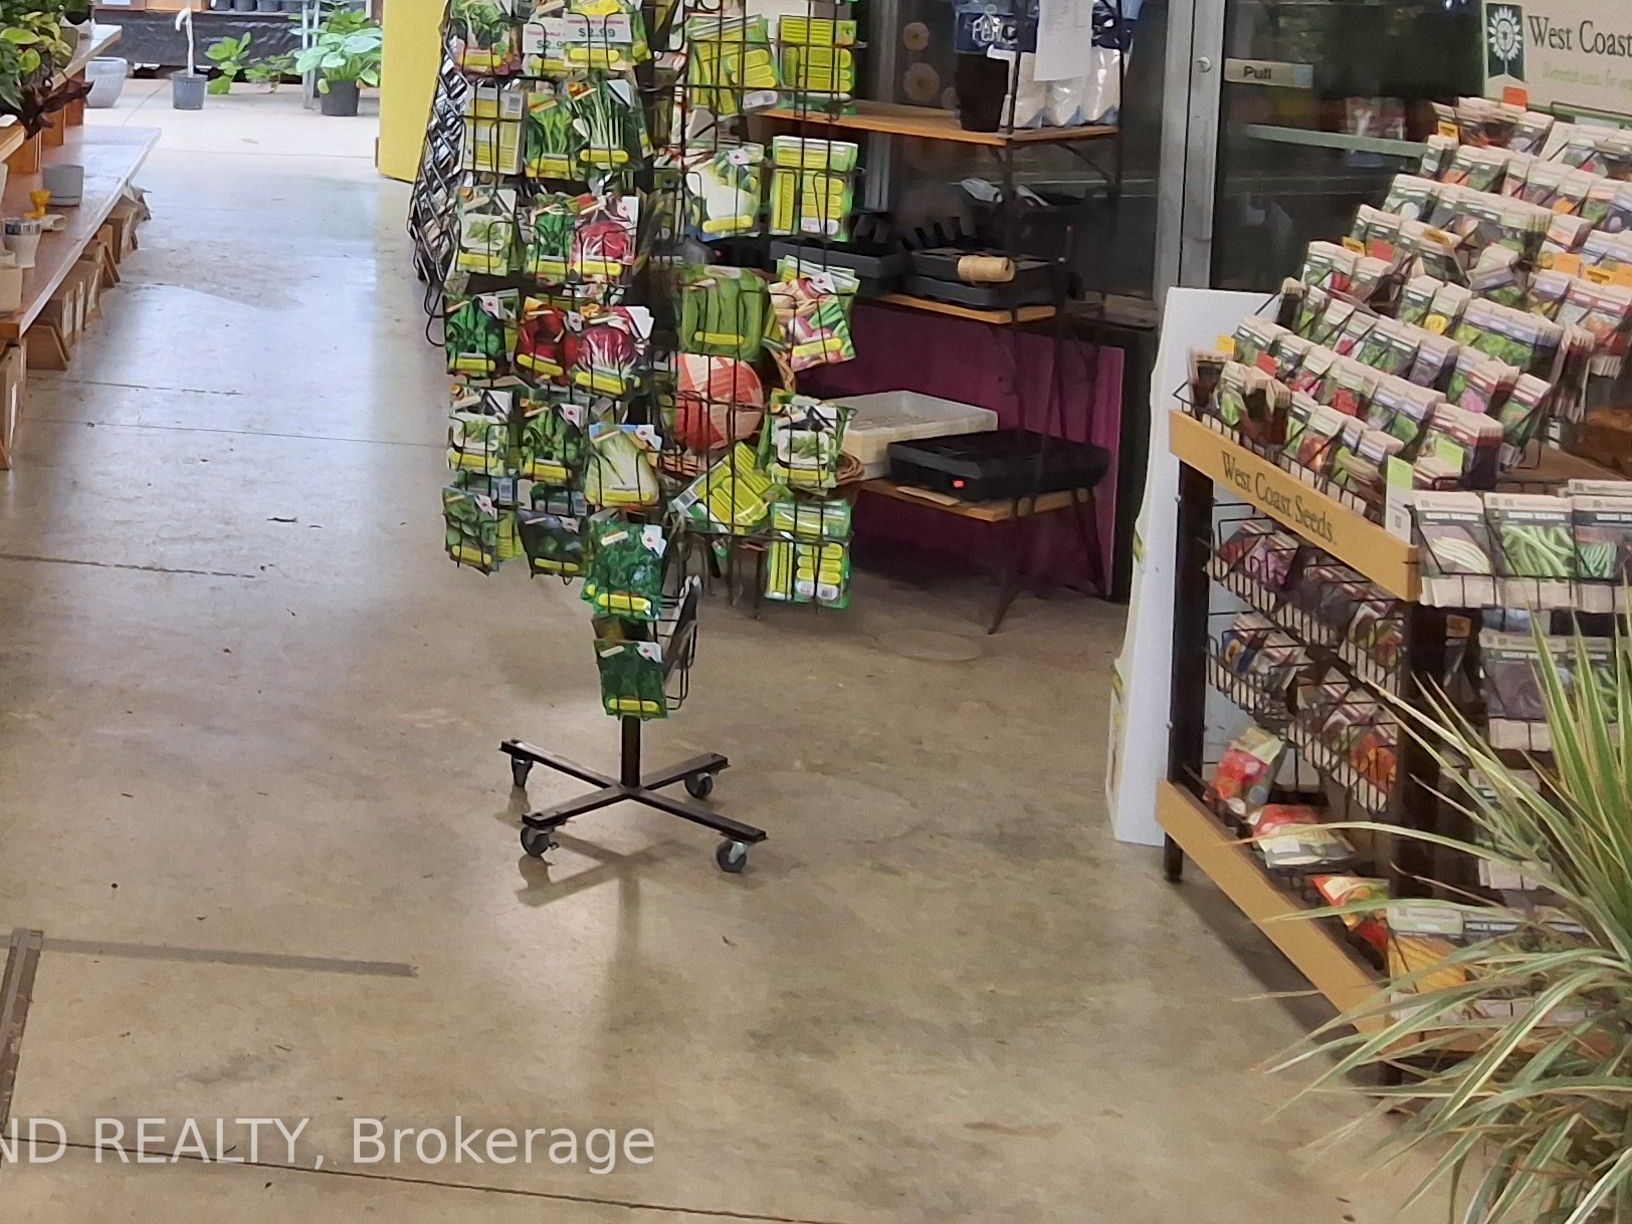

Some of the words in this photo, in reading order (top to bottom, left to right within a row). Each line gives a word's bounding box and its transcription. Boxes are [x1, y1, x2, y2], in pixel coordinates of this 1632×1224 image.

[1527, 14, 1573, 51] West
[1243, 65, 1272, 80] Pull
[1222, 451, 1253, 493] West
[1255, 472, 1292, 518] Coast
[1295, 495, 1333, 543] Seeds
